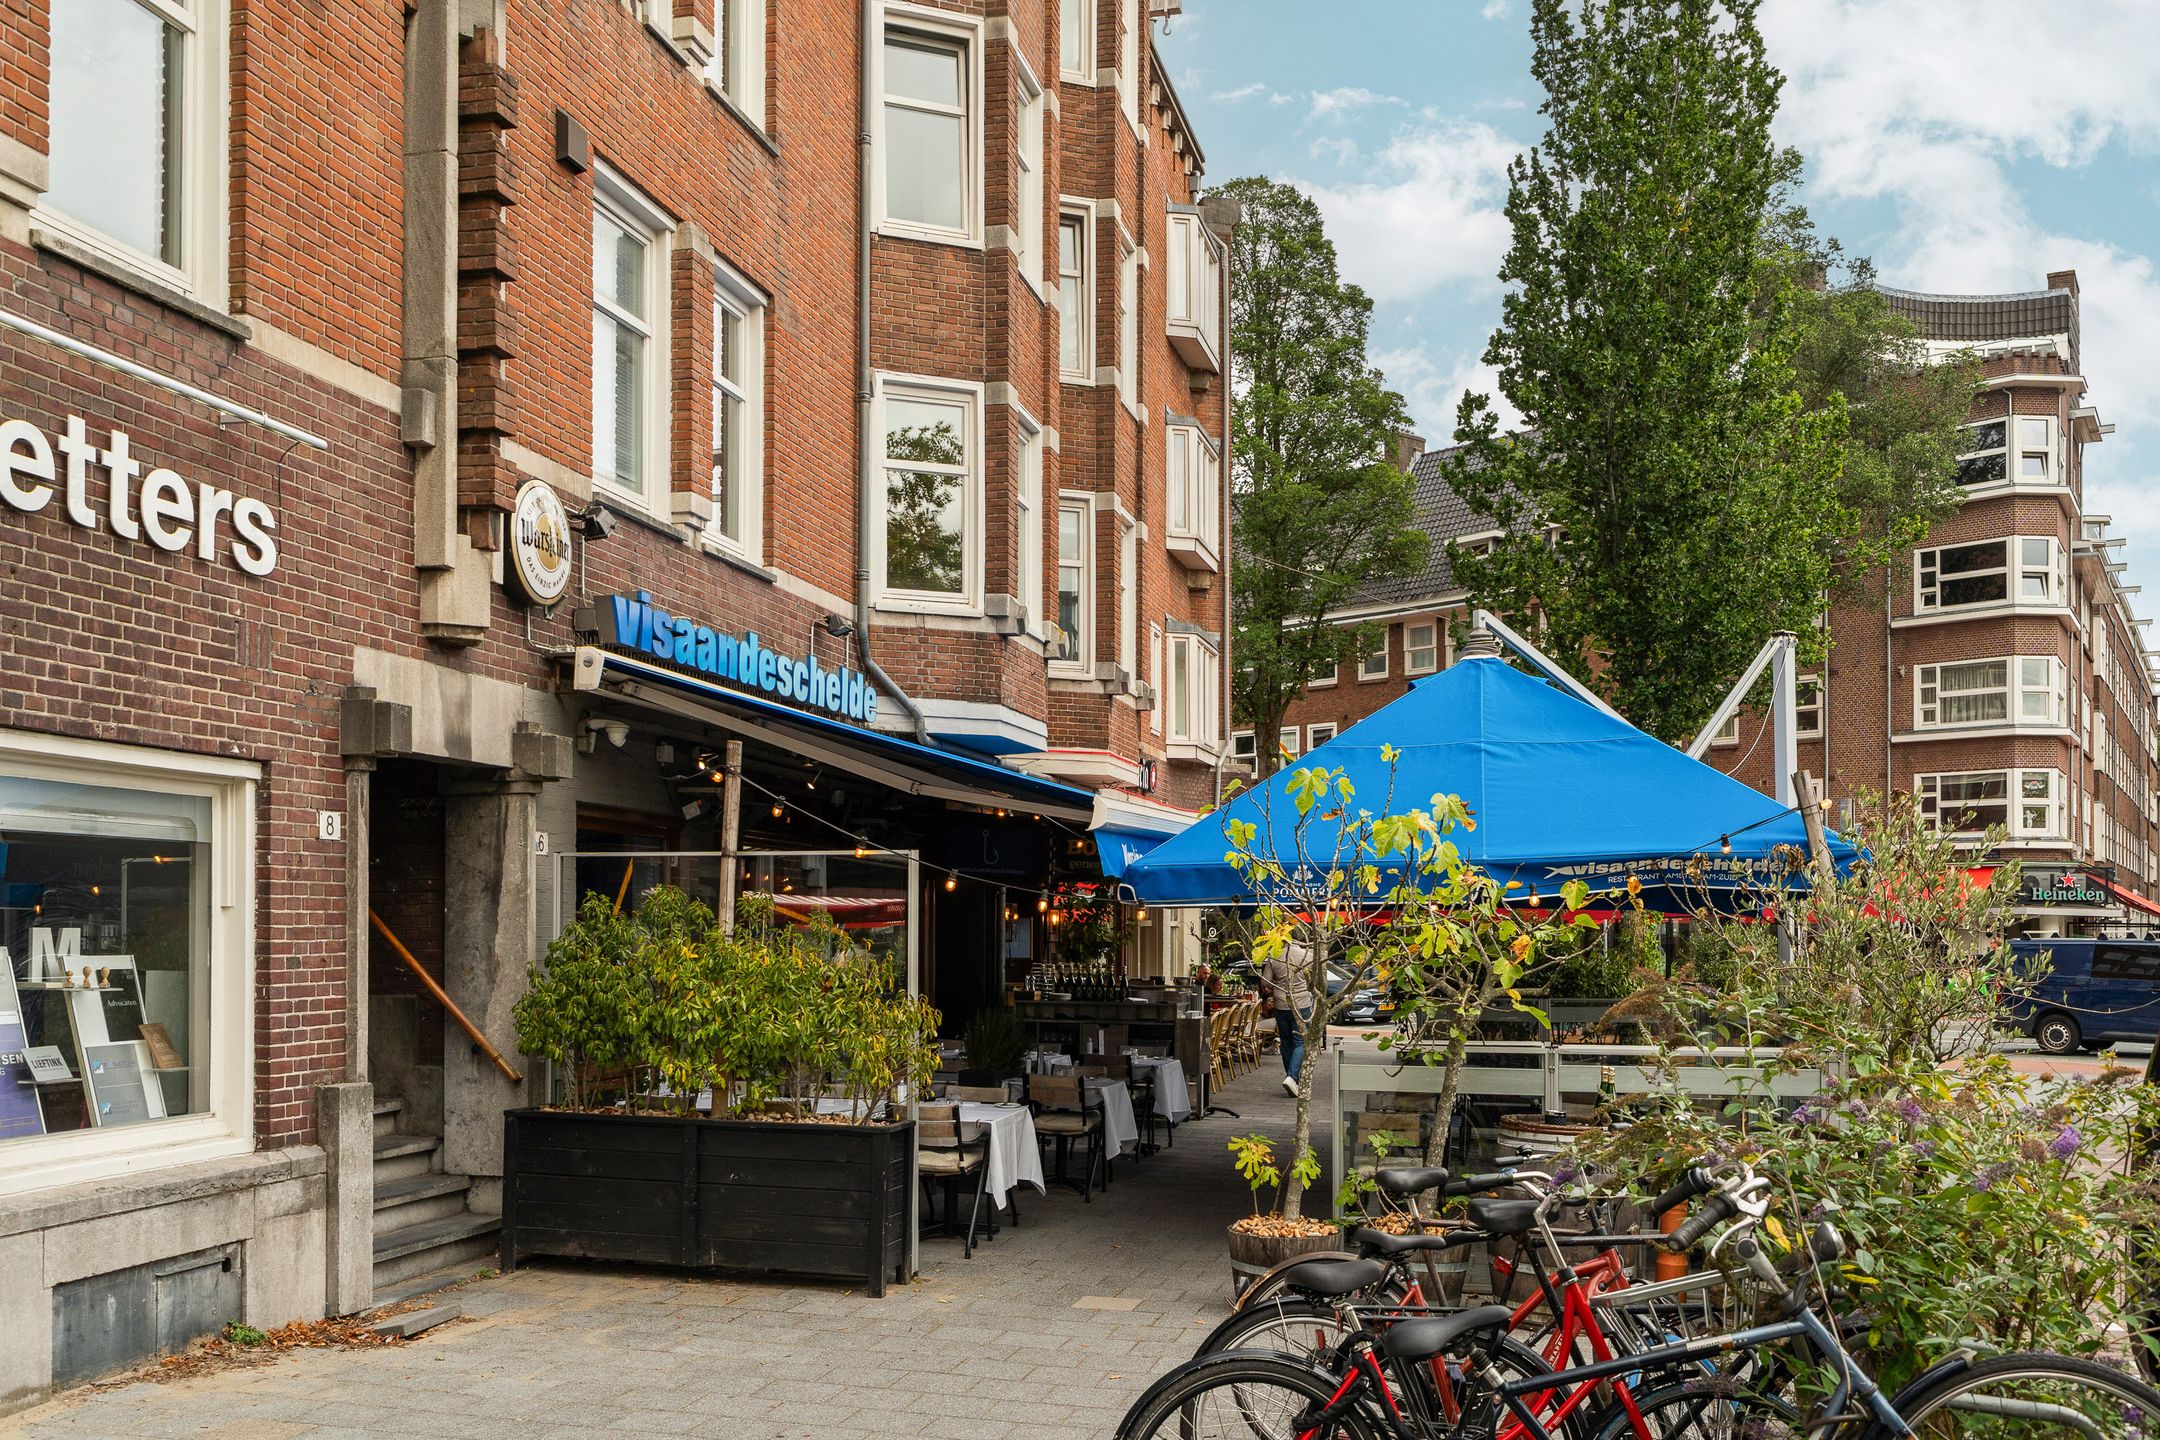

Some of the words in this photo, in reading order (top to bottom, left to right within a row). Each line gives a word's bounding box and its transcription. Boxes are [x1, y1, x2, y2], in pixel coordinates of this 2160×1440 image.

[0, 413, 277, 576] etters
[612, 589, 878, 724] visaandeschelde
[326, 815, 334, 836] 8
[538, 834, 545, 852] 6
[1608, 872, 1661, 884] RESTRANT
[1665, 871, 1738, 882] AMSTAM-ZUID
[2031, 886, 2106, 902] Heineken
[31, 1057, 64, 1069] LIEFTINK
